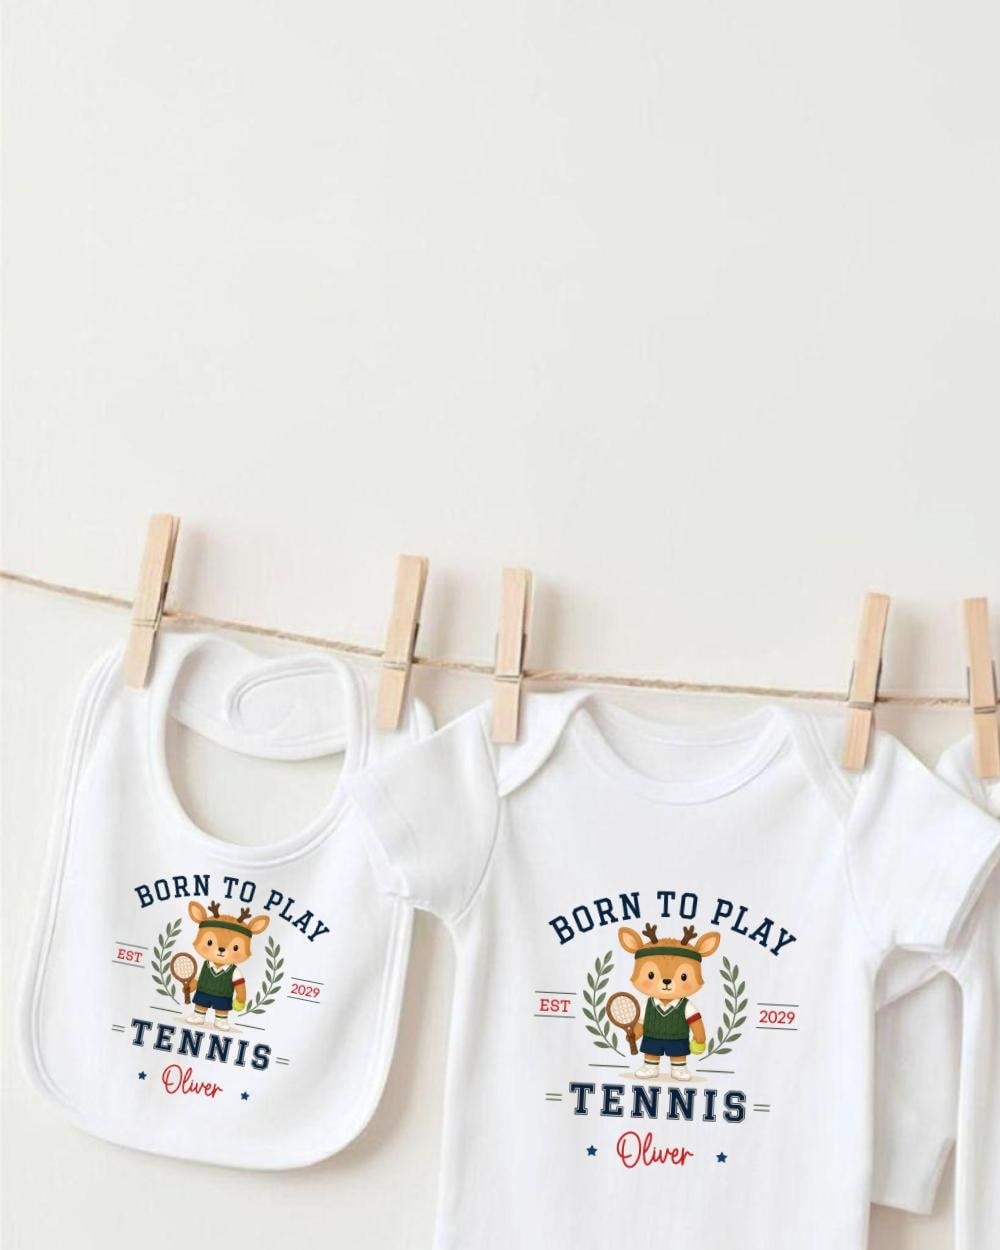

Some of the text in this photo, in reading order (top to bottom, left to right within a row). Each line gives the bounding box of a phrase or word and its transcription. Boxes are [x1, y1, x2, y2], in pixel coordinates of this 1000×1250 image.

[133, 874, 331, 943] BORN TO PLAY
[548, 890, 797, 957] BORN TO PLAY
[117, 949, 142, 961] EST
[290, 983, 321, 998] 2029
[539, 998, 570, 1012] EST
[759, 1009, 796, 1025] 2029
[131, 1018, 272, 1071] TENNIS
[161, 1063, 222, 1098] Oliver
[568, 1081, 747, 1124] TENNIS
[615, 1130, 693, 1169] Oliver
